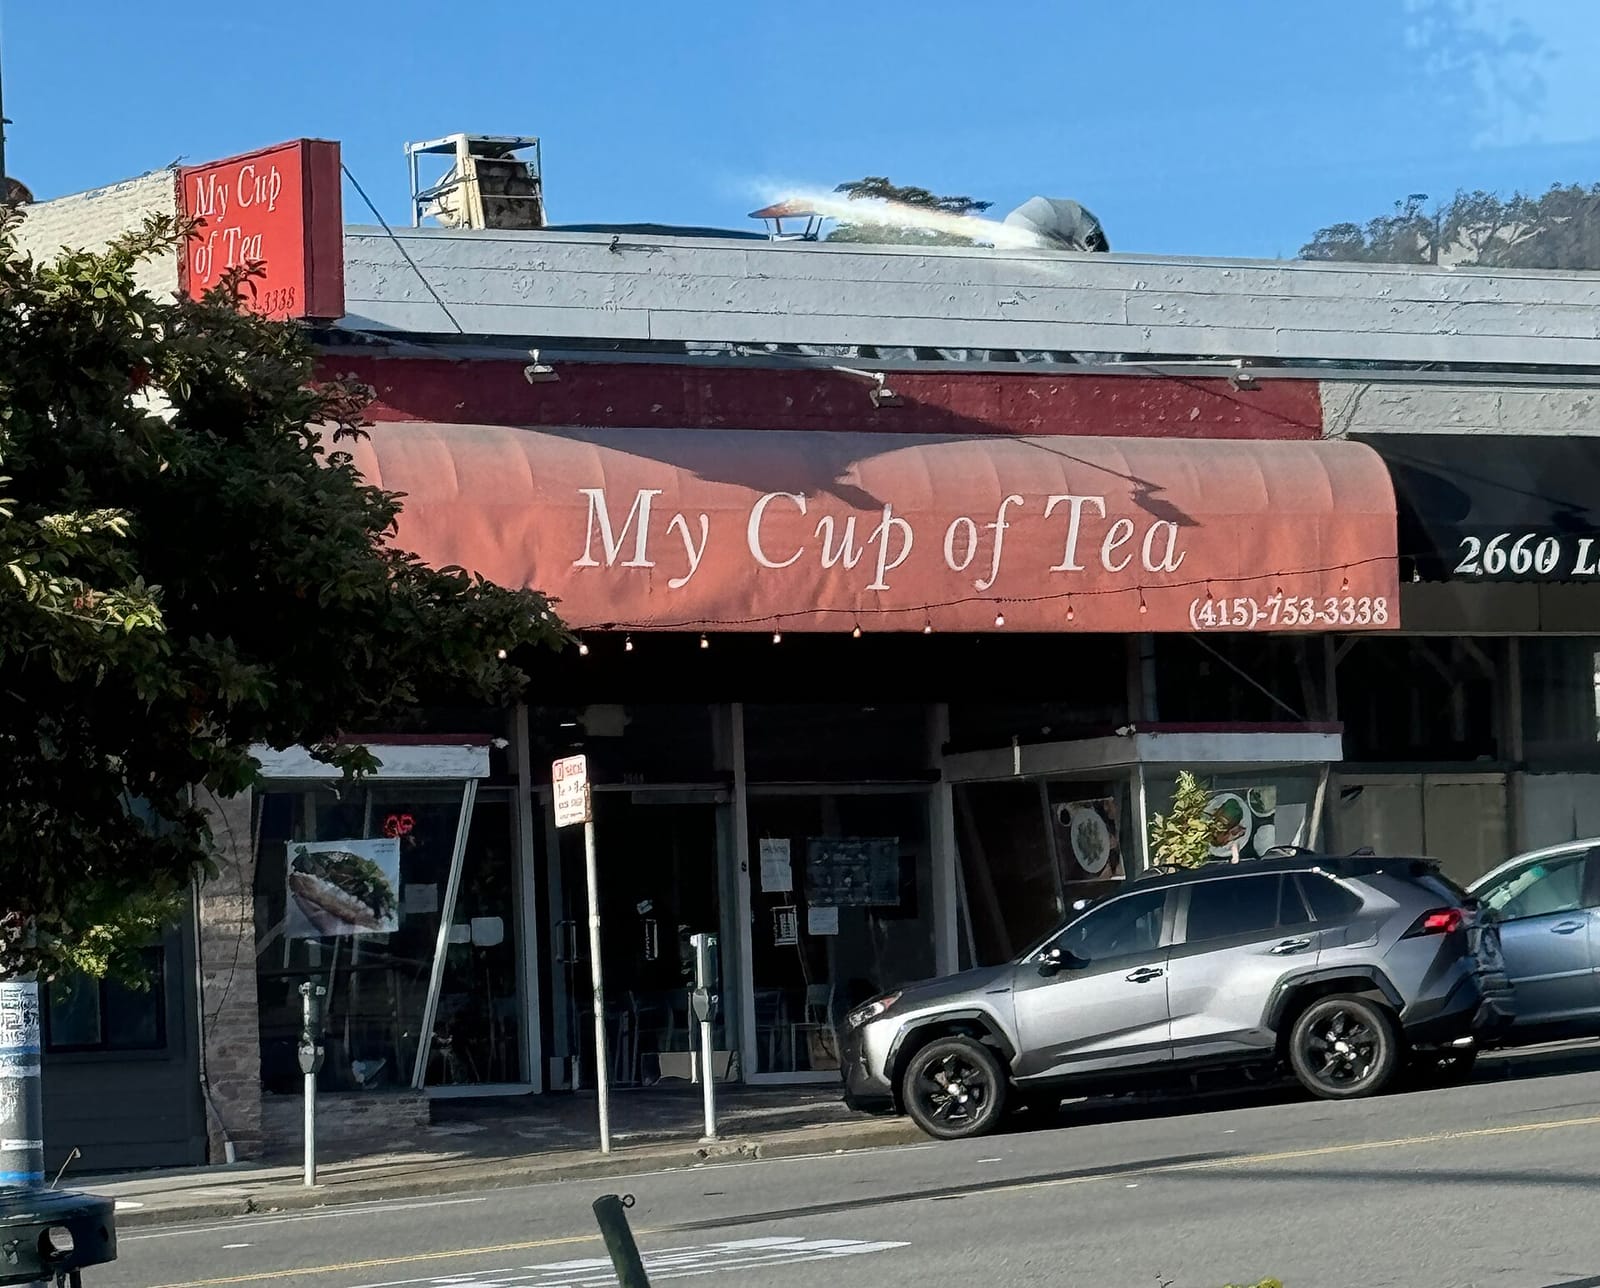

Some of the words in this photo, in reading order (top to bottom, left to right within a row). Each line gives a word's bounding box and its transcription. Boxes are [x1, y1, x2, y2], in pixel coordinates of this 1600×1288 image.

[195, 175, 228, 222] My
[238, 165, 280, 211] Cup
[195, 231, 217, 283] of
[223, 227, 263, 267] Tea
[572, 488, 709, 589] My
[747, 491, 914, 591] Cup
[943, 494, 1025, 592] of
[1044, 494, 1187, 574] Tea
[1453, 532, 1561, 576] 2660
[1570, 538, 1600, 576] L
[1189, 597, 1388, 631] (415)-753-3338
